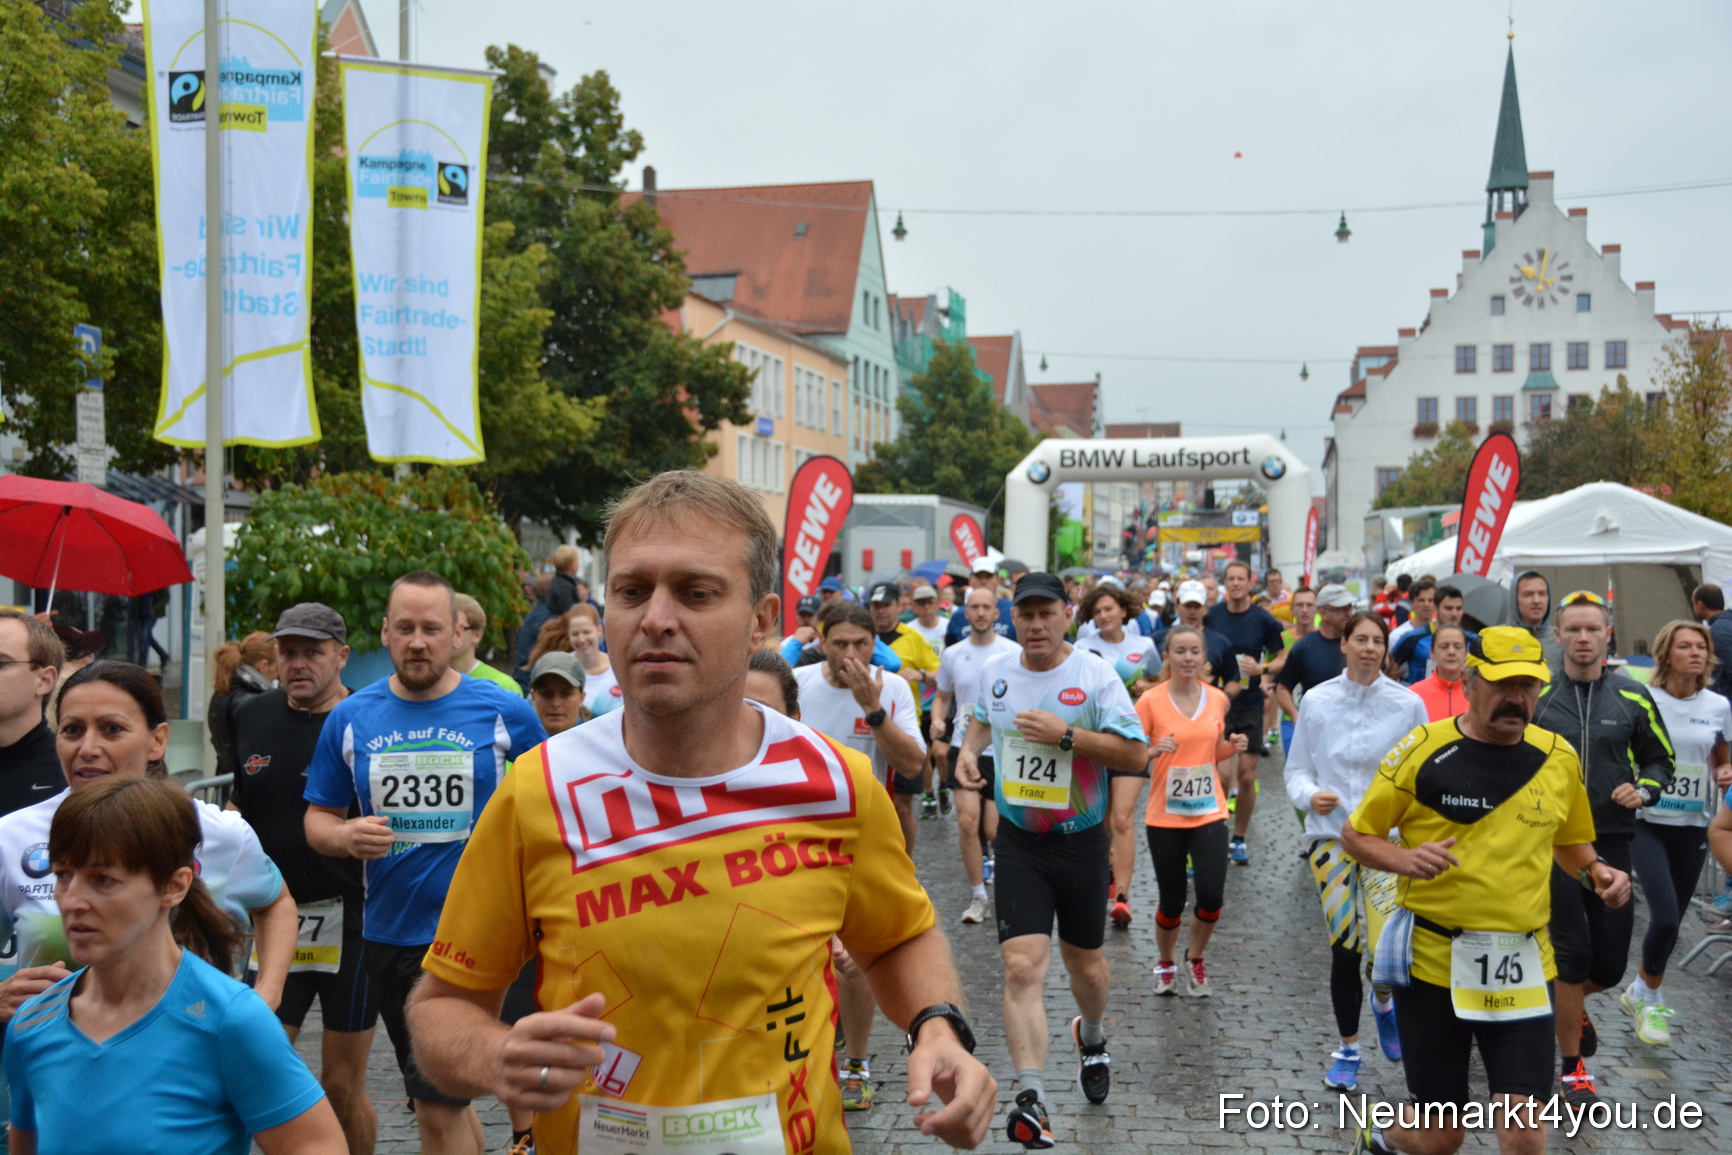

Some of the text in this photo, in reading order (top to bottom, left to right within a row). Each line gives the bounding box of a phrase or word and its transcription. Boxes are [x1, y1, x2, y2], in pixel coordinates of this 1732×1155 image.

[360, 157, 426, 171] Kampagne
[361, 170, 432, 187] Fairtrade
[390, 192, 427, 204] Towns
[359, 272, 448, 297] Wir sind
[361, 304, 466, 329] Fairtrade-
[364, 335, 427, 357] Stadt!
[1060, 447, 1250, 471] BMW Laufsport
[1461, 453, 1512, 575] REWE
[787, 472, 843, 595] REWE
[367, 727, 474, 751] Wyk auf Föhr
[415, 755, 464, 765] BOCK
[1016, 755, 1057, 782] 124
[382, 774, 464, 807] 2336
[1020, 786, 1045, 798] Franz
[1173, 777, 1211, 797] 2473
[1442, 794, 1494, 809] Heinz L.
[1661, 799, 1686, 810] Ulrike
[391, 817, 455, 830] Alexander
[1516, 813, 1555, 828] Burgthann
[575, 832, 853, 928] MAX BÖGL
[1474, 952, 1523, 985] 145
[1484, 995, 1516, 1008] Heinz
[594, 1119, 650, 1139] NeuerMarkt
[662, 1104, 761, 1138] BOCK
